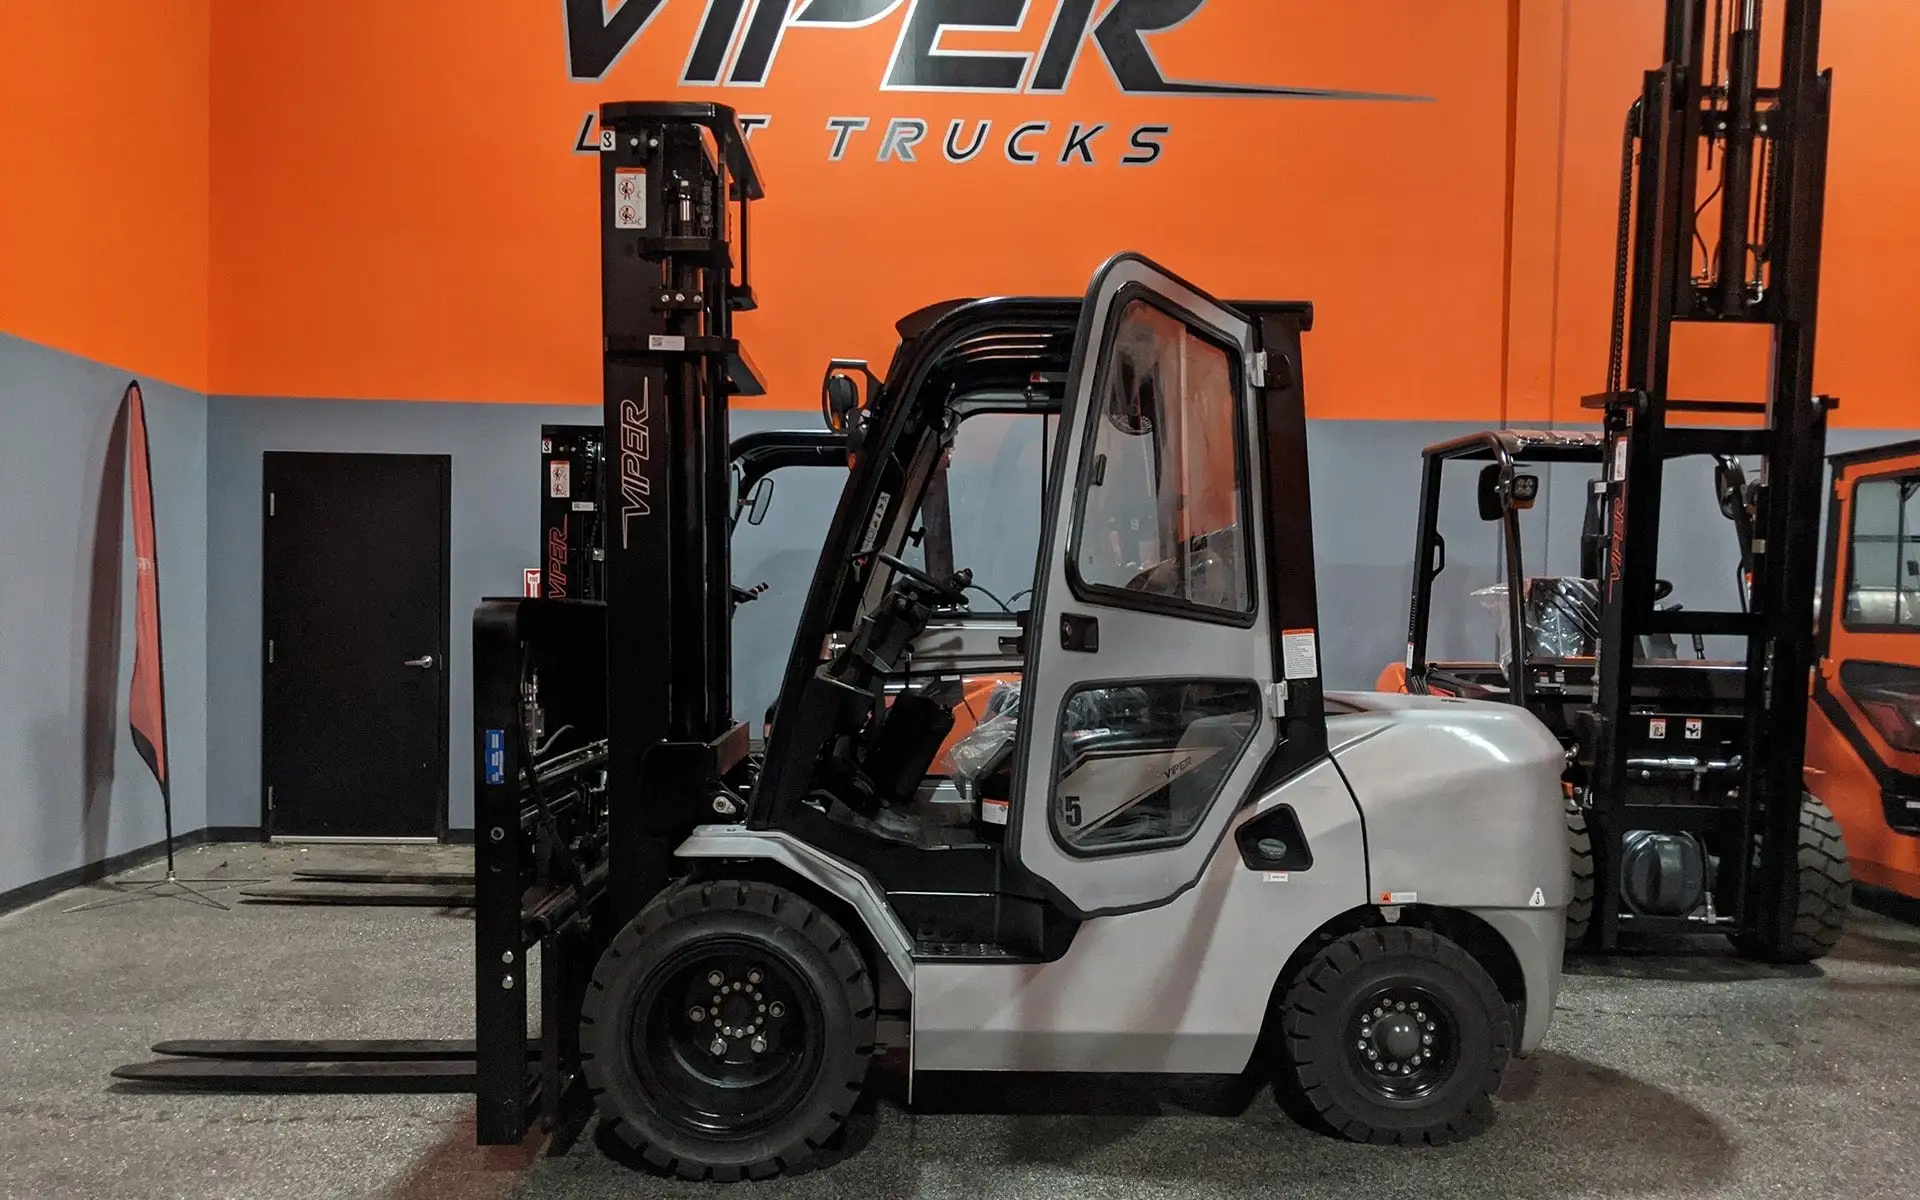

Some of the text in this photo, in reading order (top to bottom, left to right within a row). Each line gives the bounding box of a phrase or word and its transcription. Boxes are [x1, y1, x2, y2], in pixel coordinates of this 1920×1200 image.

[564, 0, 1435, 103] VIPER
[571, 110, 1173, 165] LT TRUCKS
[619, 377, 651, 549] VIPER
[548, 513, 568, 599] VIPER
[1162, 756, 1193, 779] VIPER
